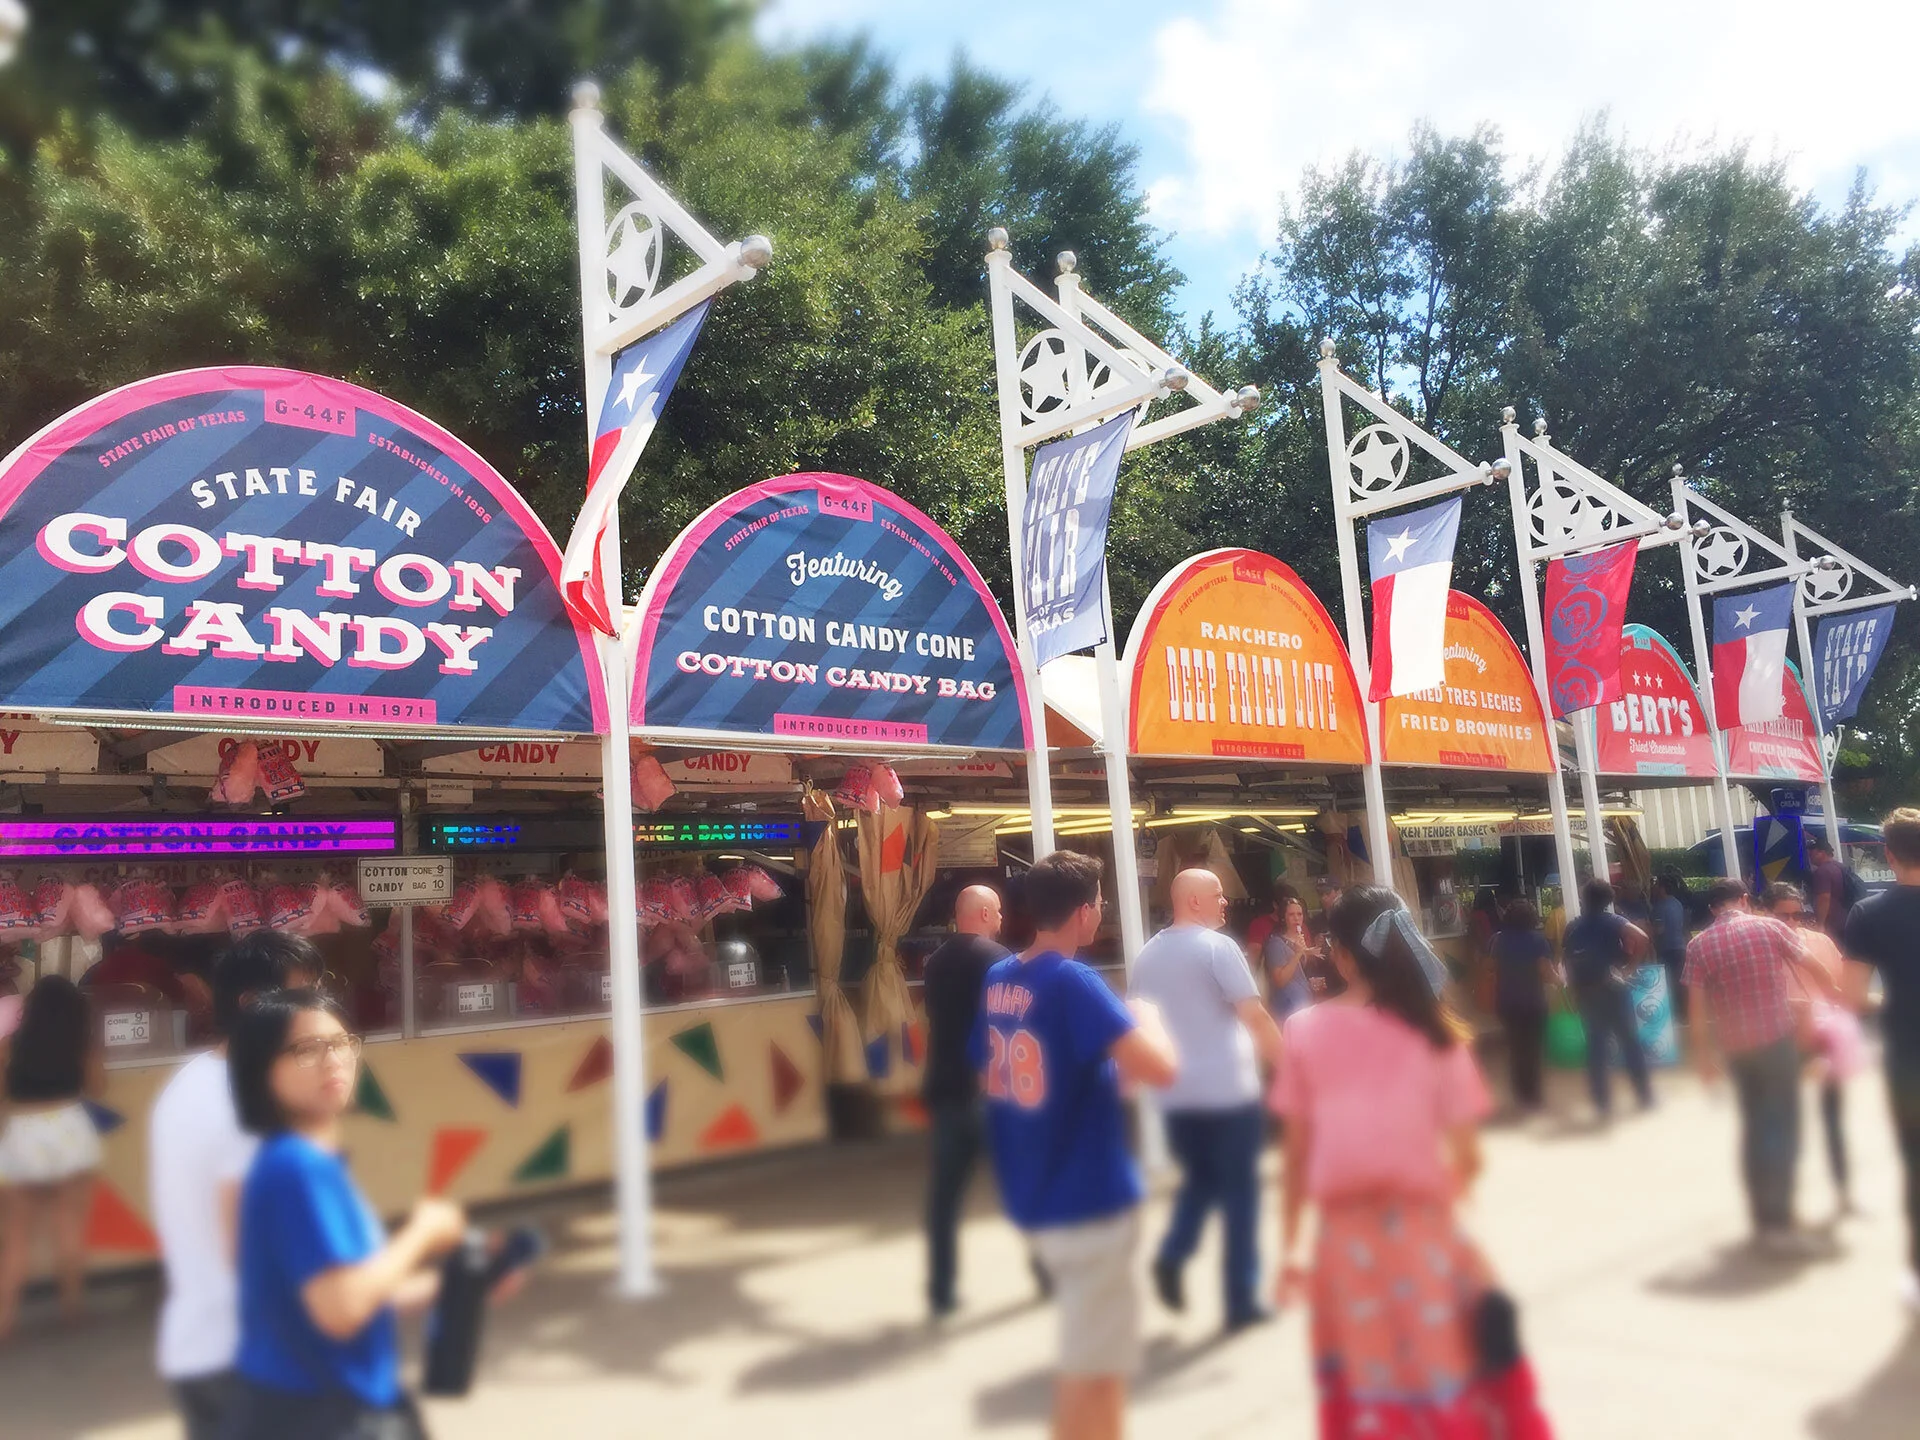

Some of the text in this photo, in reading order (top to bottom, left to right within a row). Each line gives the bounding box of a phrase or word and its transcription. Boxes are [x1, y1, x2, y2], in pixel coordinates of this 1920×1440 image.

[275, 400, 346, 425] G-44F
[98, 410, 246, 468] STATE FAIR OF TEXAS
[368, 432, 493, 524] ESTABLISHED IN 1886
[191, 466, 423, 538] STATE FAIR
[824, 496, 868, 514] G-44F
[724, 505, 810, 551] STATE FAIR OF TEXAS
[1024, 440, 1102, 613] STATE FAIR
[880, 518, 931, 558] ESTABLISHED
[931, 555, 940, 566] IN
[36, 512, 521, 617] COTTON
[786, 550, 904, 600] Featuring
[1028, 607, 1076, 639] TEXAS
[1037, 603, 1051, 617] OF
[75, 591, 493, 676] CANDY
[703, 605, 976, 661] COTTON CANDY CONE
[1200, 621, 1303, 650] RANCHERO
[1825, 619, 1877, 661] STATE
[1443, 642, 1487, 674] eaturing
[676, 651, 997, 701] COTTON CANDY BAG
[1165, 646, 1338, 732] DEEP FRIED LOVE
[190, 694, 426, 718] INTRODUCED IN 1971
[1446, 687, 1478, 708] TRES
[1480, 691, 1523, 714] LECHES
[782, 720, 921, 739] INTRODUCED IN 1971
[1400, 713, 1532, 741] FRIED BROWNIES
[1610, 693, 1693, 738] BERT'S
[217, 737, 321, 763] CDY
[478, 743, 560, 764] CANDY
[683, 752, 752, 772] CANDY
[53, 825, 348, 852] COTTON CANDY
[632, 825, 675, 841] AKE
[1399, 826, 1420, 838] KEN
[1423, 825, 1455, 838] TENDER
[1457, 824, 1488, 837] BASKET
[1569, 819, 1588, 831] FRIED
[365, 864, 444, 877] COTTON CONE 9
[369, 879, 444, 892] CANDY BAG 10
[135, 1011, 143, 1022] 9
[131, 1026, 145, 1037] 10
